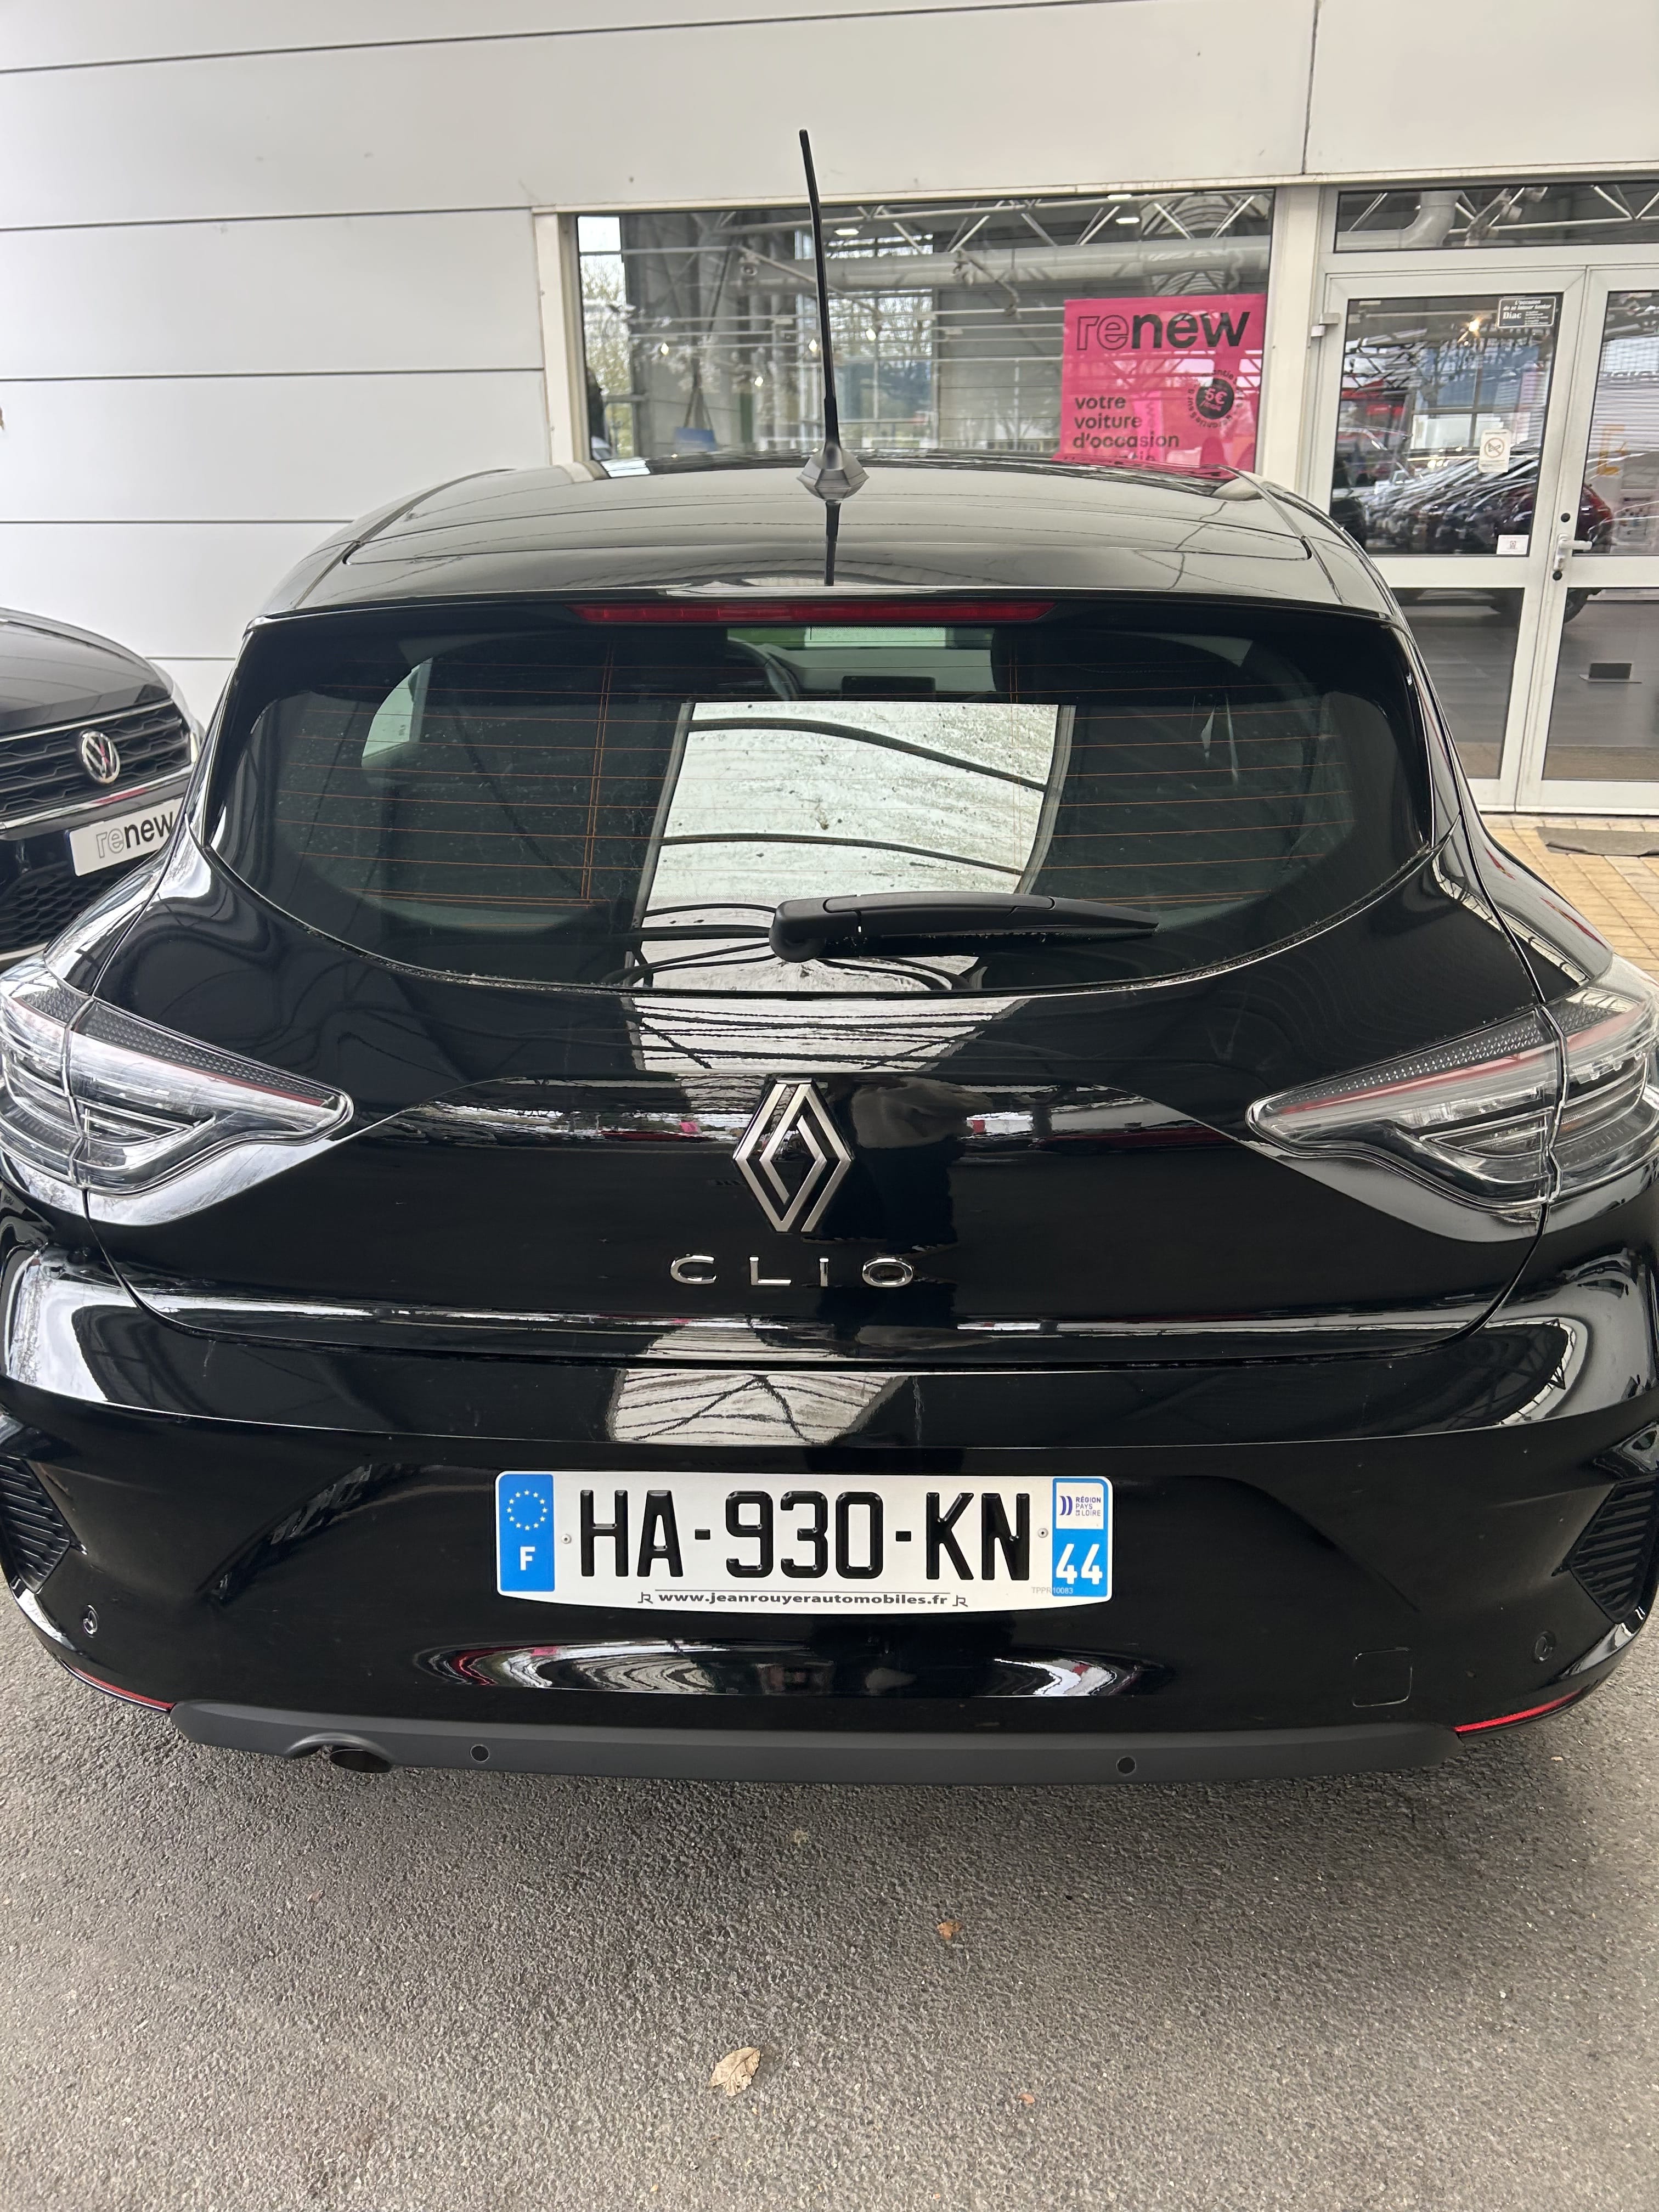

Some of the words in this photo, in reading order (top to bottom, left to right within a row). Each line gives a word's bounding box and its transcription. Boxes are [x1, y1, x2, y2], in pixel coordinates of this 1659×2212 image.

[1076, 312, 1251, 351] renew
[1075, 396, 1126, 409] votre
[1074, 413, 1142, 429] voiture
[1073, 431, 1179, 448] d'occasion
[95, 812, 174, 859] renew
[670, 1254, 913, 1287] CLIO
[580, 1489, 1030, 1581] HA-930-KN
[520, 1547, 535, 1571] F
[1056, 1543, 1103, 1584] 44
[659, 1593, 947, 1605] www.jeanrouyerautomobiles.fr
